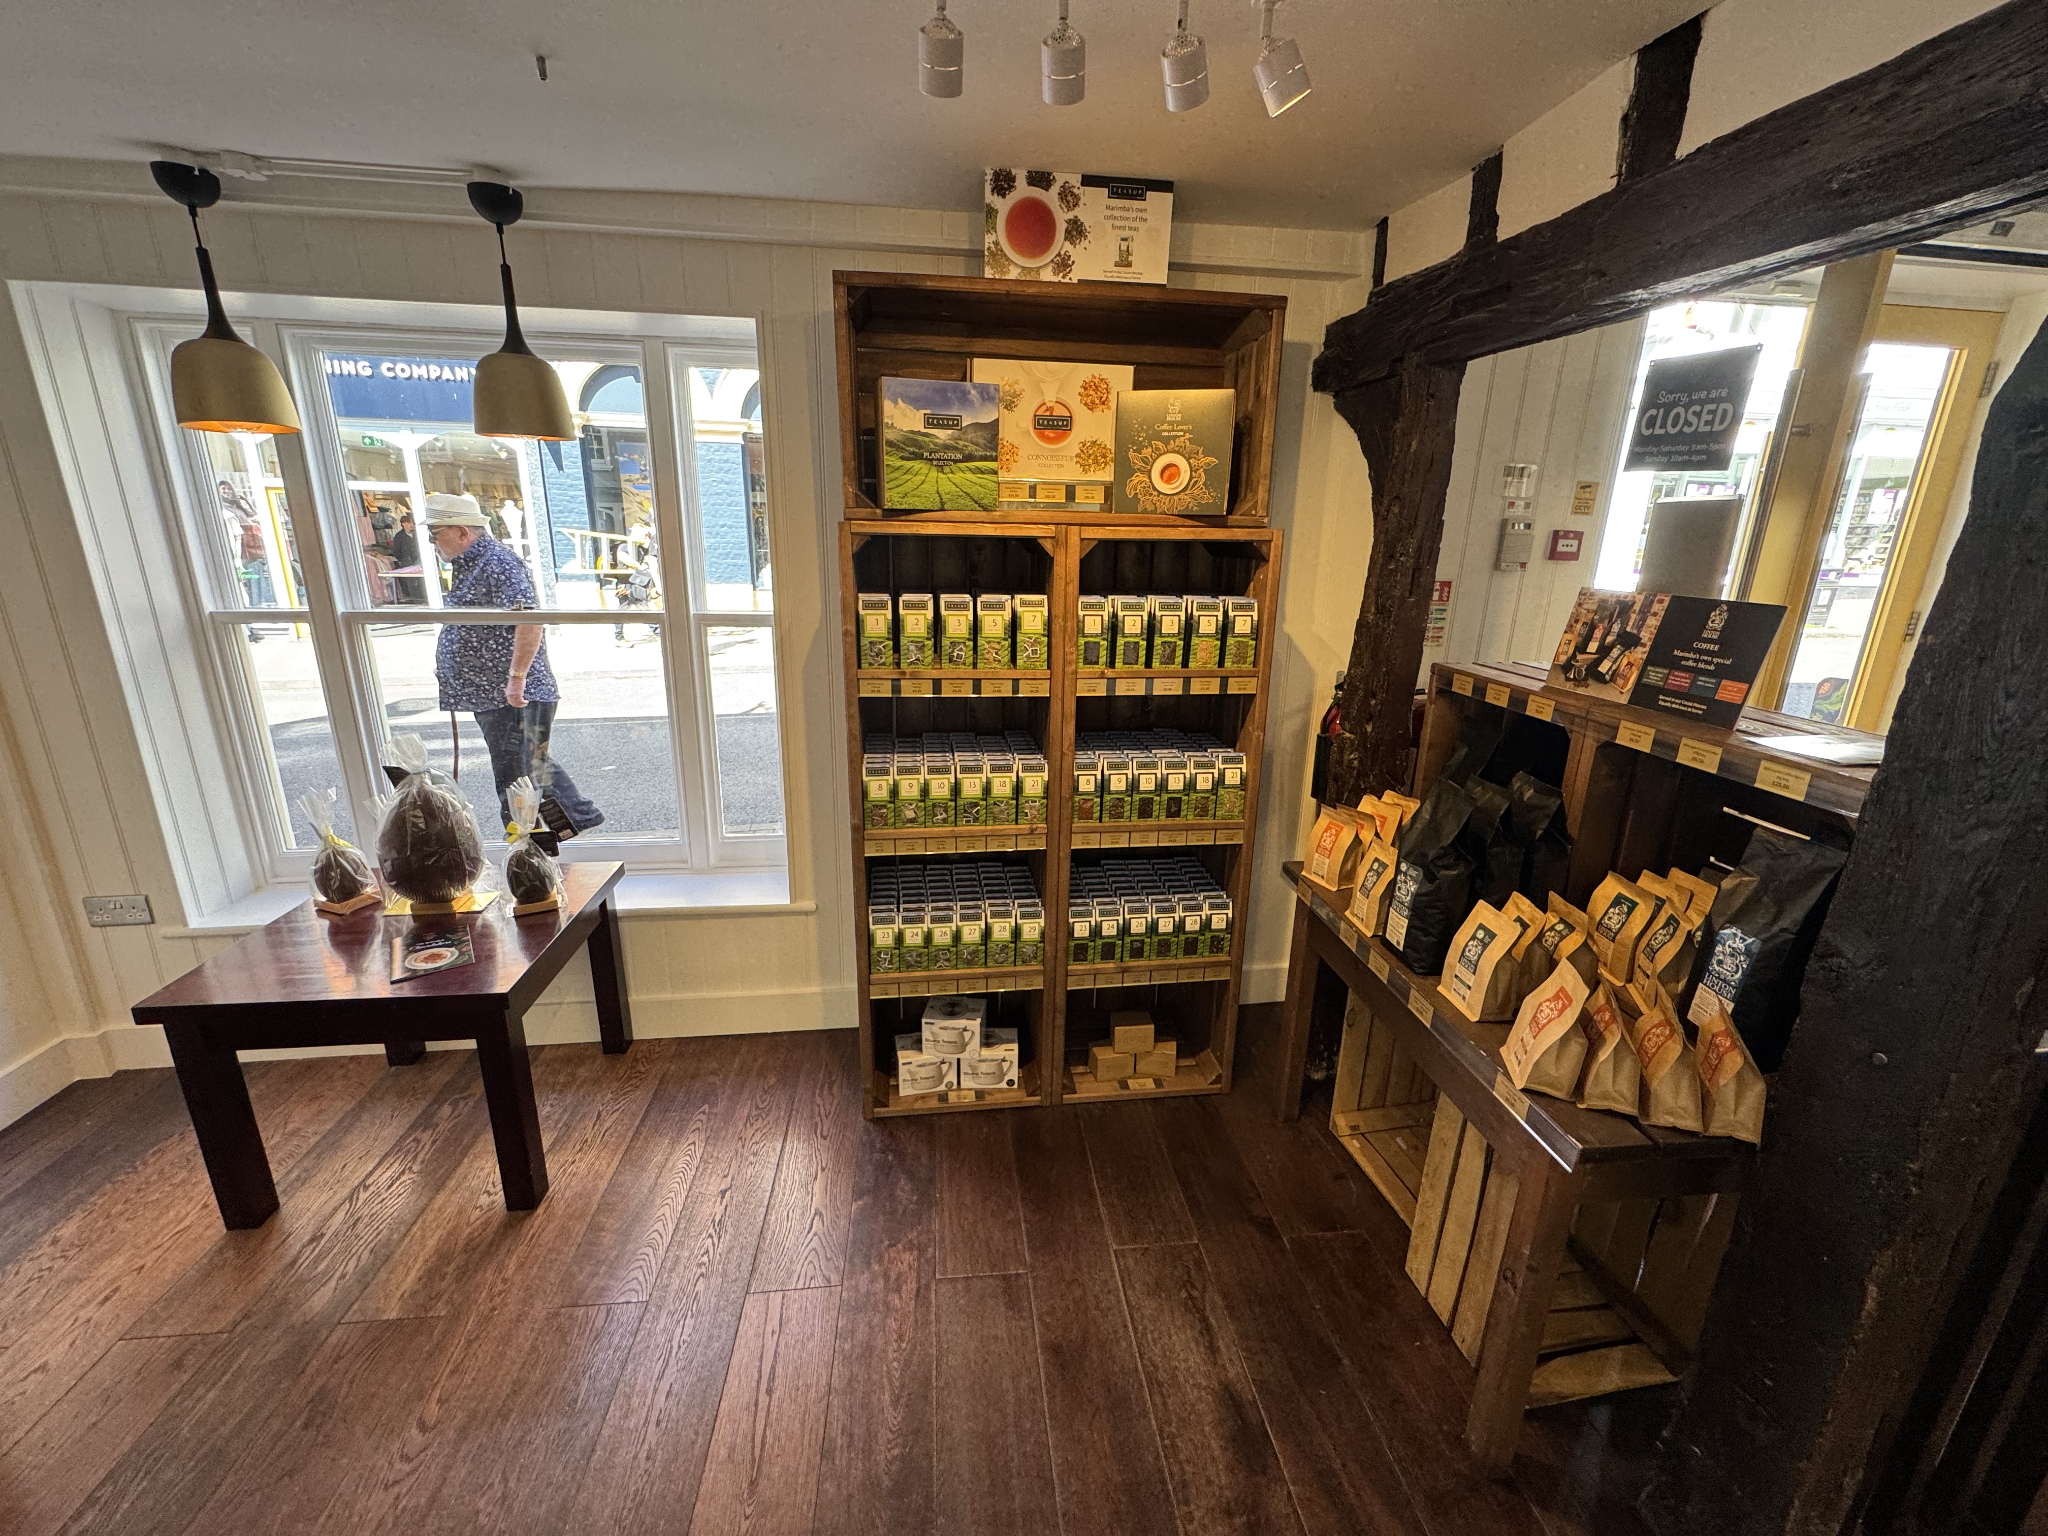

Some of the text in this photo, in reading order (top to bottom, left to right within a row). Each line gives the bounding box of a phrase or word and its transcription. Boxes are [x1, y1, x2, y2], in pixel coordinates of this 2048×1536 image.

[1105, 204, 1134, 213] Marimba's
[1103, 214, 1131, 222] collection
[1111, 223, 1127, 231] finest
[1657, 388, 1729, 404] Sorry, we are
[1640, 402, 1735, 436] CLOSED
[923, 452, 963, 460] PLANTATION
[1026, 453, 1075, 462] CONNOISSEUR
[1645, 455, 1669, 463] Sunday
[874, 618, 879, 627] 1
[914, 618, 920, 626] 2
[956, 619, 962, 627] 3
[992, 619, 997, 627] 5
[1031, 615, 1036, 623] 7
[1092, 619, 1096, 627] 1
[1131, 619, 1137, 627] 2
[1169, 619, 1174, 627] 3
[1207, 619, 1212, 627] 5
[1242, 619, 1247, 627] 7
[1693, 641, 1720, 651] COFFEE
[1673, 650, 1699, 660] Marimba's
[1712, 655, 1732, 665] special
[1681, 660, 1716, 670] coffee blends
[999, 780, 1007, 788] 18
[1031, 779, 1039, 787] 21
[1085, 778, 1090, 786] 8
[1145, 777, 1153, 785] 10
[1202, 776, 1210, 784] 18
[877, 783, 883, 791] 8
[908, 782, 913, 790] 9
[937, 782, 945, 790] 10
[969, 781, 977, 789] 13
[1772, 780, 1790, 790] £25.00
[968, 928, 977, 936] 27
[998, 925, 1007, 933] 28
[882, 931, 890, 939] 23
[939, 930, 948, 938] 26
[1704, 972, 1736, 995] LINTON
[1702, 977, 1733, 1000] HOUSE
